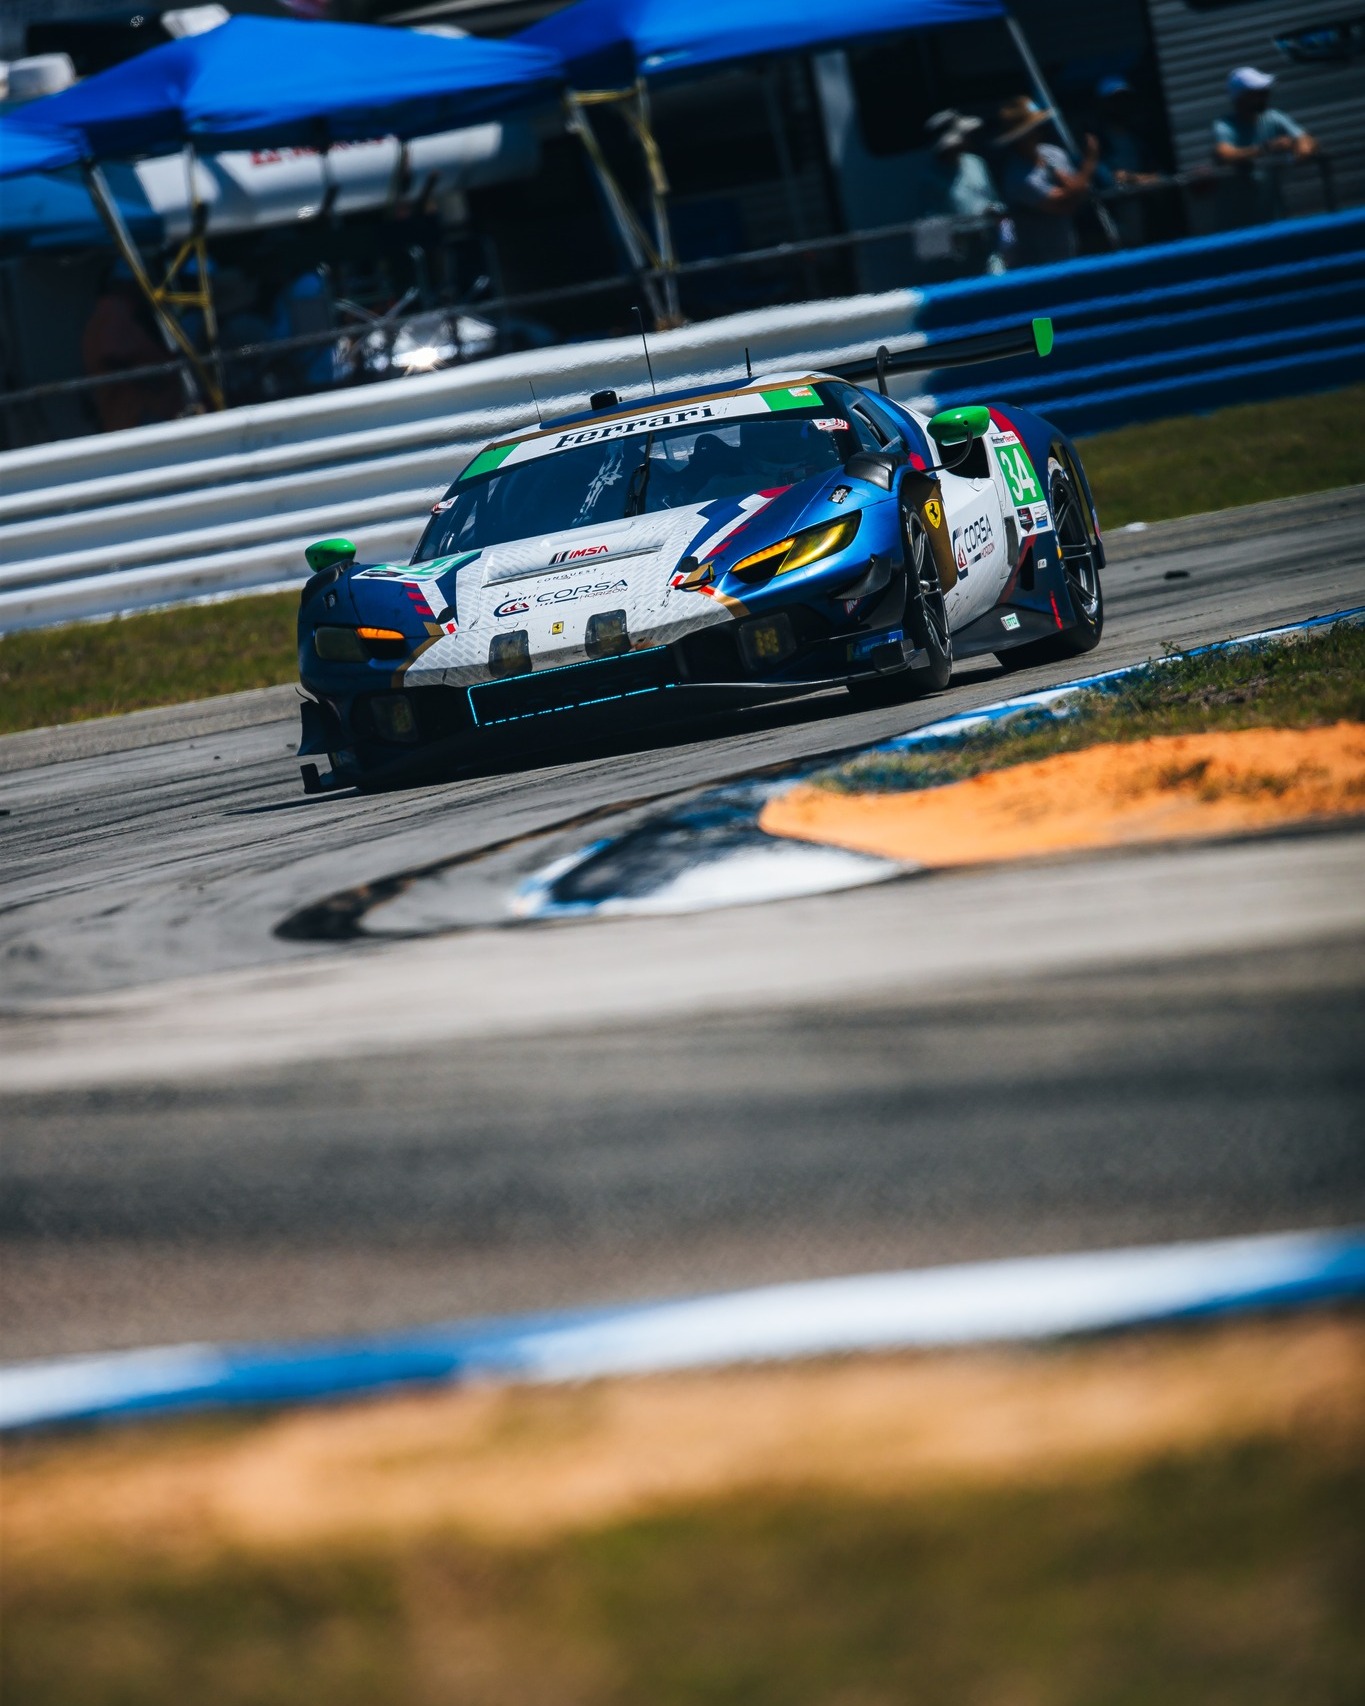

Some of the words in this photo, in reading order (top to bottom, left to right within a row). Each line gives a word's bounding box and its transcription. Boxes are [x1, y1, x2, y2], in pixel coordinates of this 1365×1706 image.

[549, 404, 716, 451] Ferrari
[1000, 448, 1037, 501] 34
[964, 513, 993, 553] CORSA
[569, 545, 609, 559] IMSA
[536, 568, 598, 584] CONQUEST
[536, 579, 628, 603] CORSA
[580, 587, 629, 600] HORIZON
